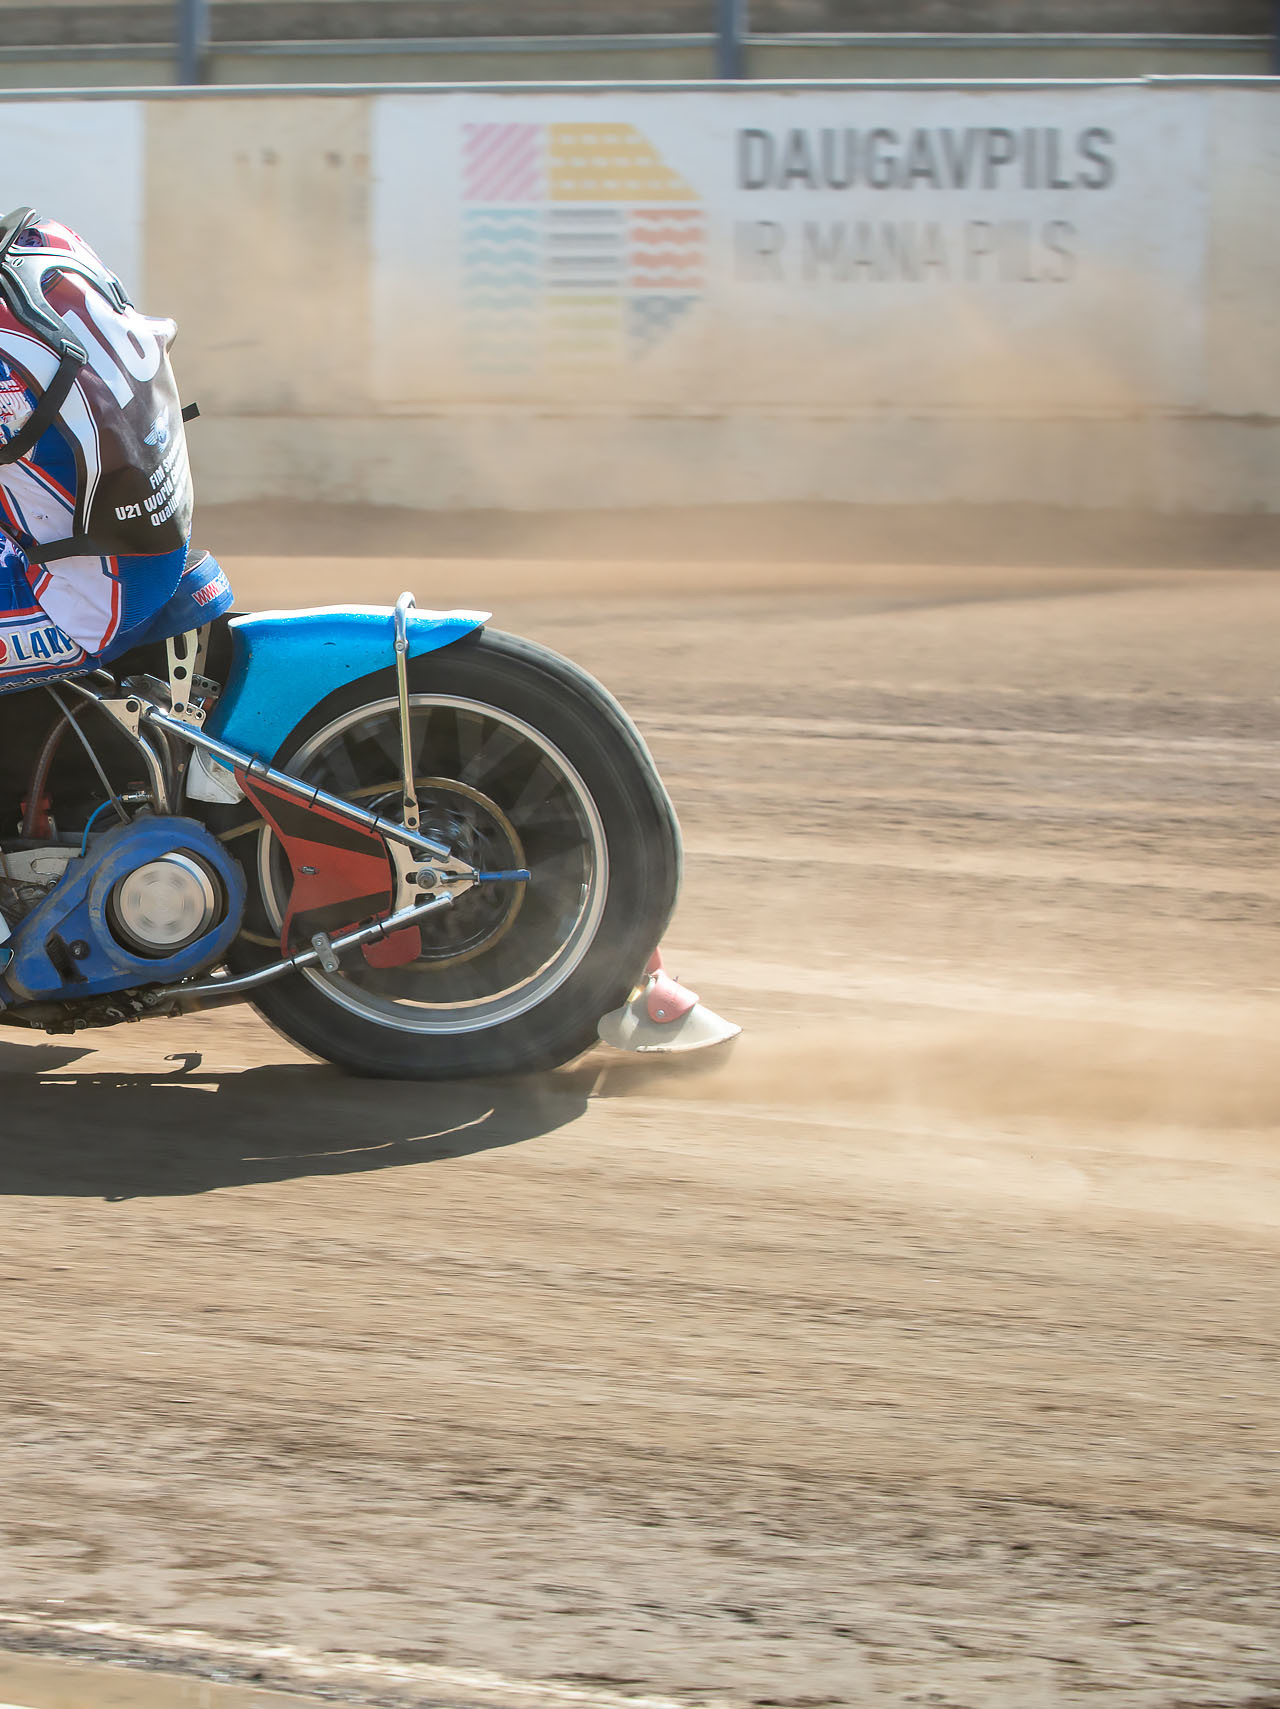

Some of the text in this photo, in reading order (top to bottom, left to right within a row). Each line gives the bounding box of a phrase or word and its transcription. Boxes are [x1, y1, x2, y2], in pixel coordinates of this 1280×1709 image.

[733, 125, 1118, 191] DAUGAVPILS
[801, 219, 951, 283] MANA
[964, 219, 1079, 283] PILS
[115, 476, 174, 521] U21 World
[149, 465, 166, 490] FIM
